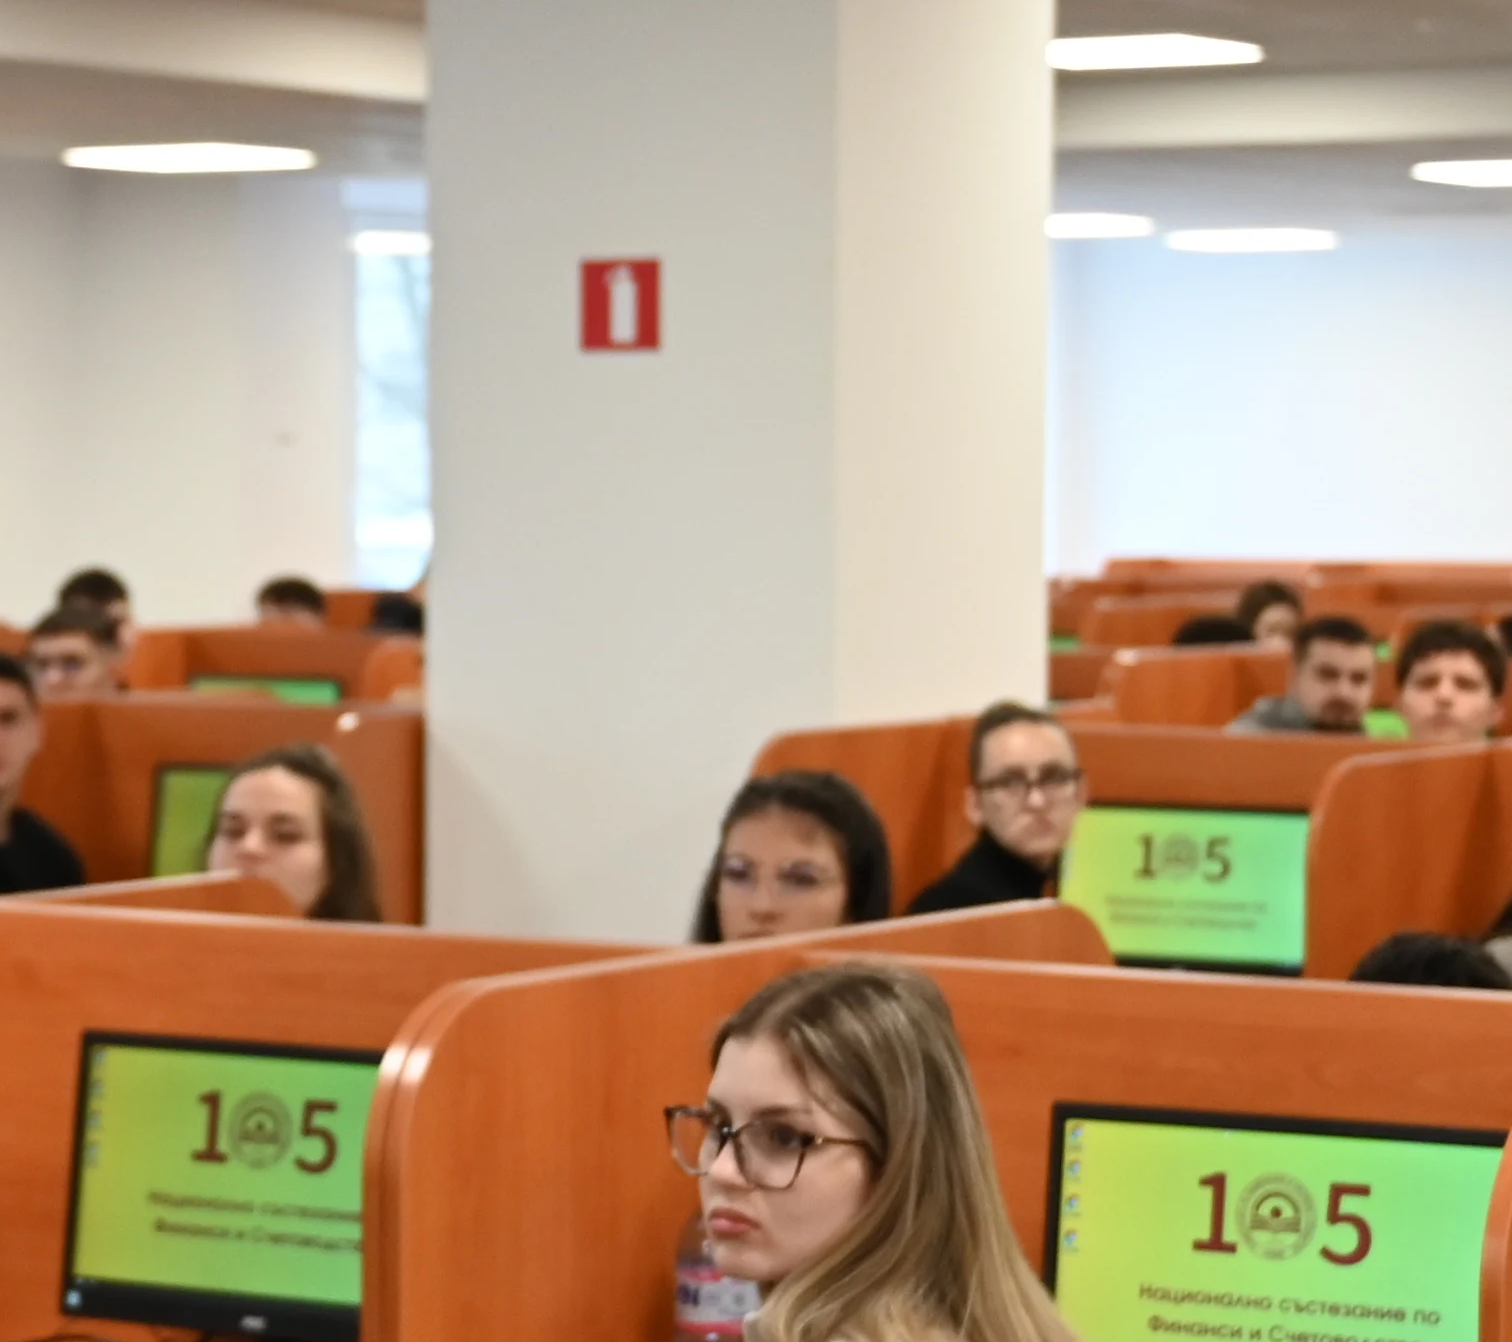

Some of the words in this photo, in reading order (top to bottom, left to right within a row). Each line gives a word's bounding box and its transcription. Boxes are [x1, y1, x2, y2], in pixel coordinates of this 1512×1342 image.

[1138, 1284, 1273, 1311] Национално
[1278, 1297, 1407, 1323] състезание
[1412, 1309, 1442, 1326] по
[1147, 1314, 1243, 1340] Финанси
[1249, 1327, 1263, 1341] и
